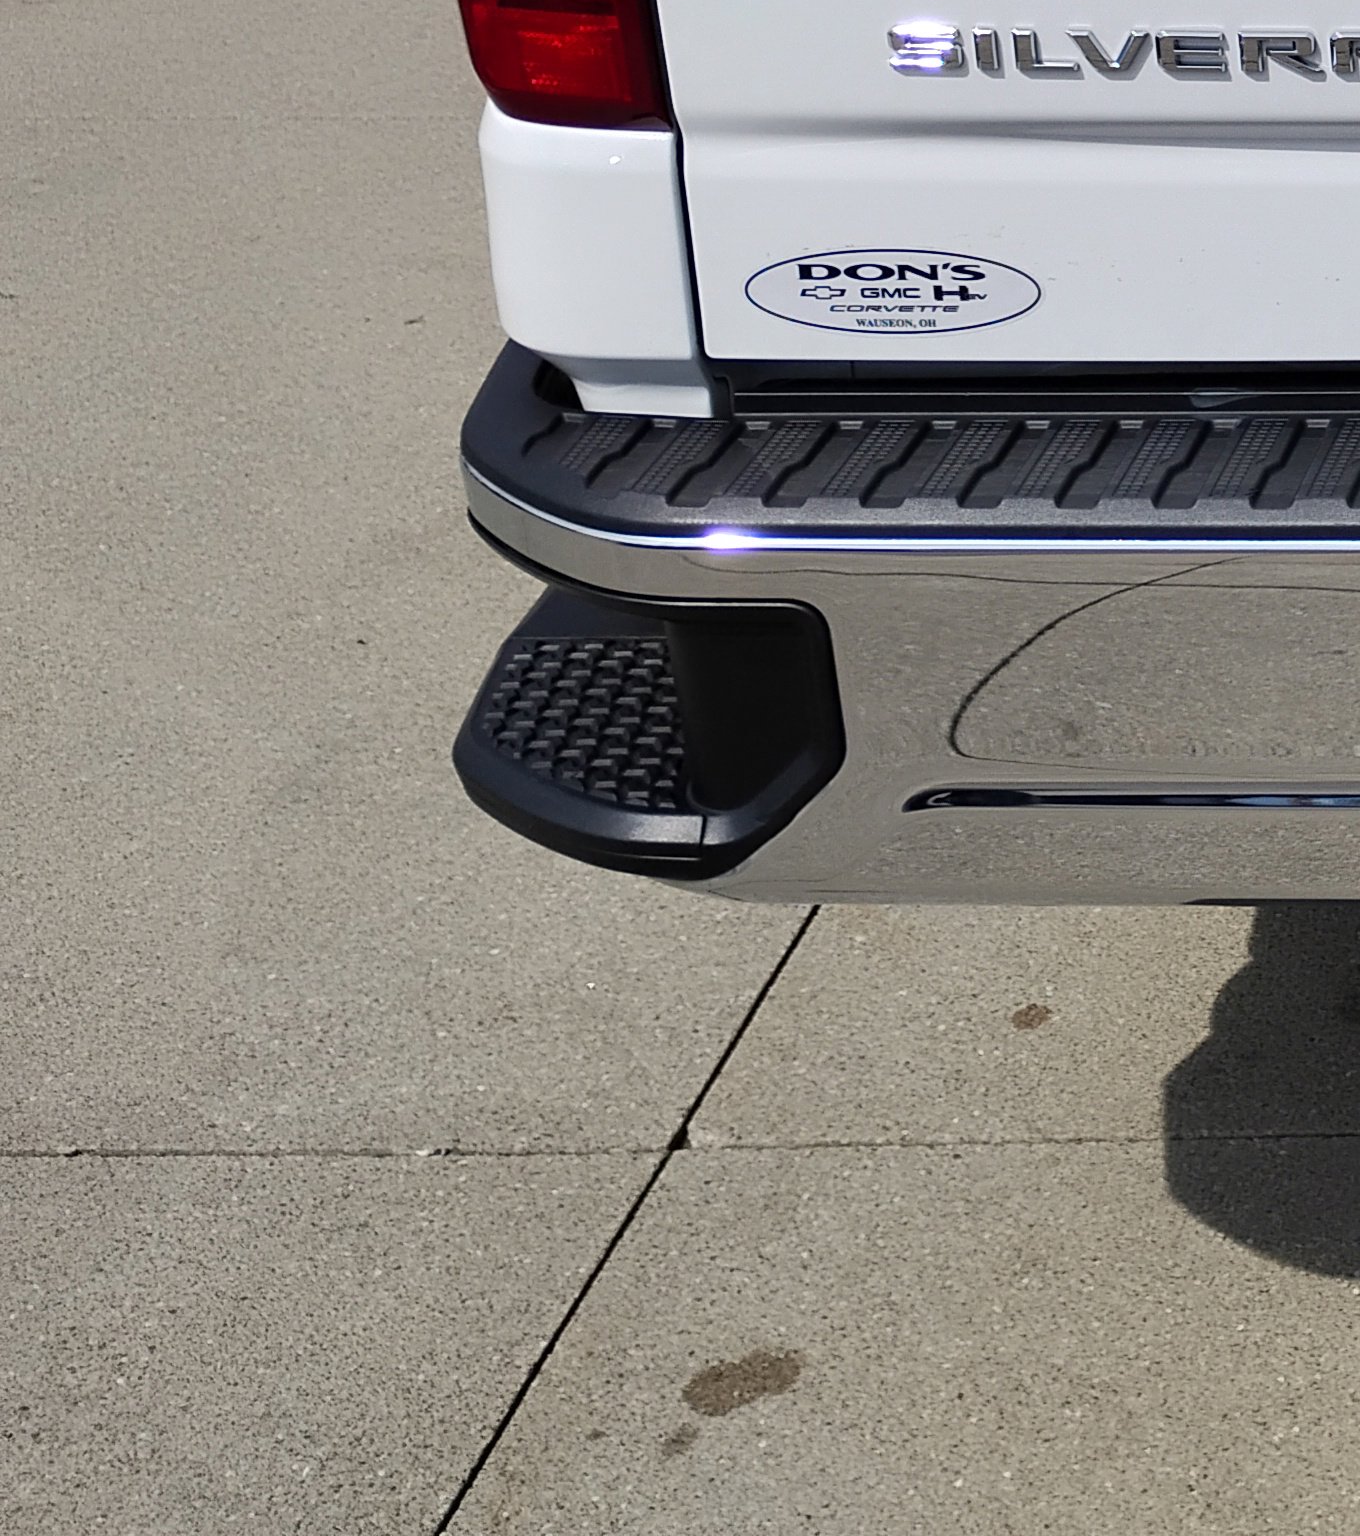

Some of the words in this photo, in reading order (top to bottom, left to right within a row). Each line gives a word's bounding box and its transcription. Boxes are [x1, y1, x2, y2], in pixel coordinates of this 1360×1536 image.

[797, 261, 986, 281] DON'S
[860, 287, 922, 299] GMC
[829, 304, 960, 313] CORVETTE
[855, 318, 917, 329] WAUSEON,
[919, 318, 938, 329] OH
